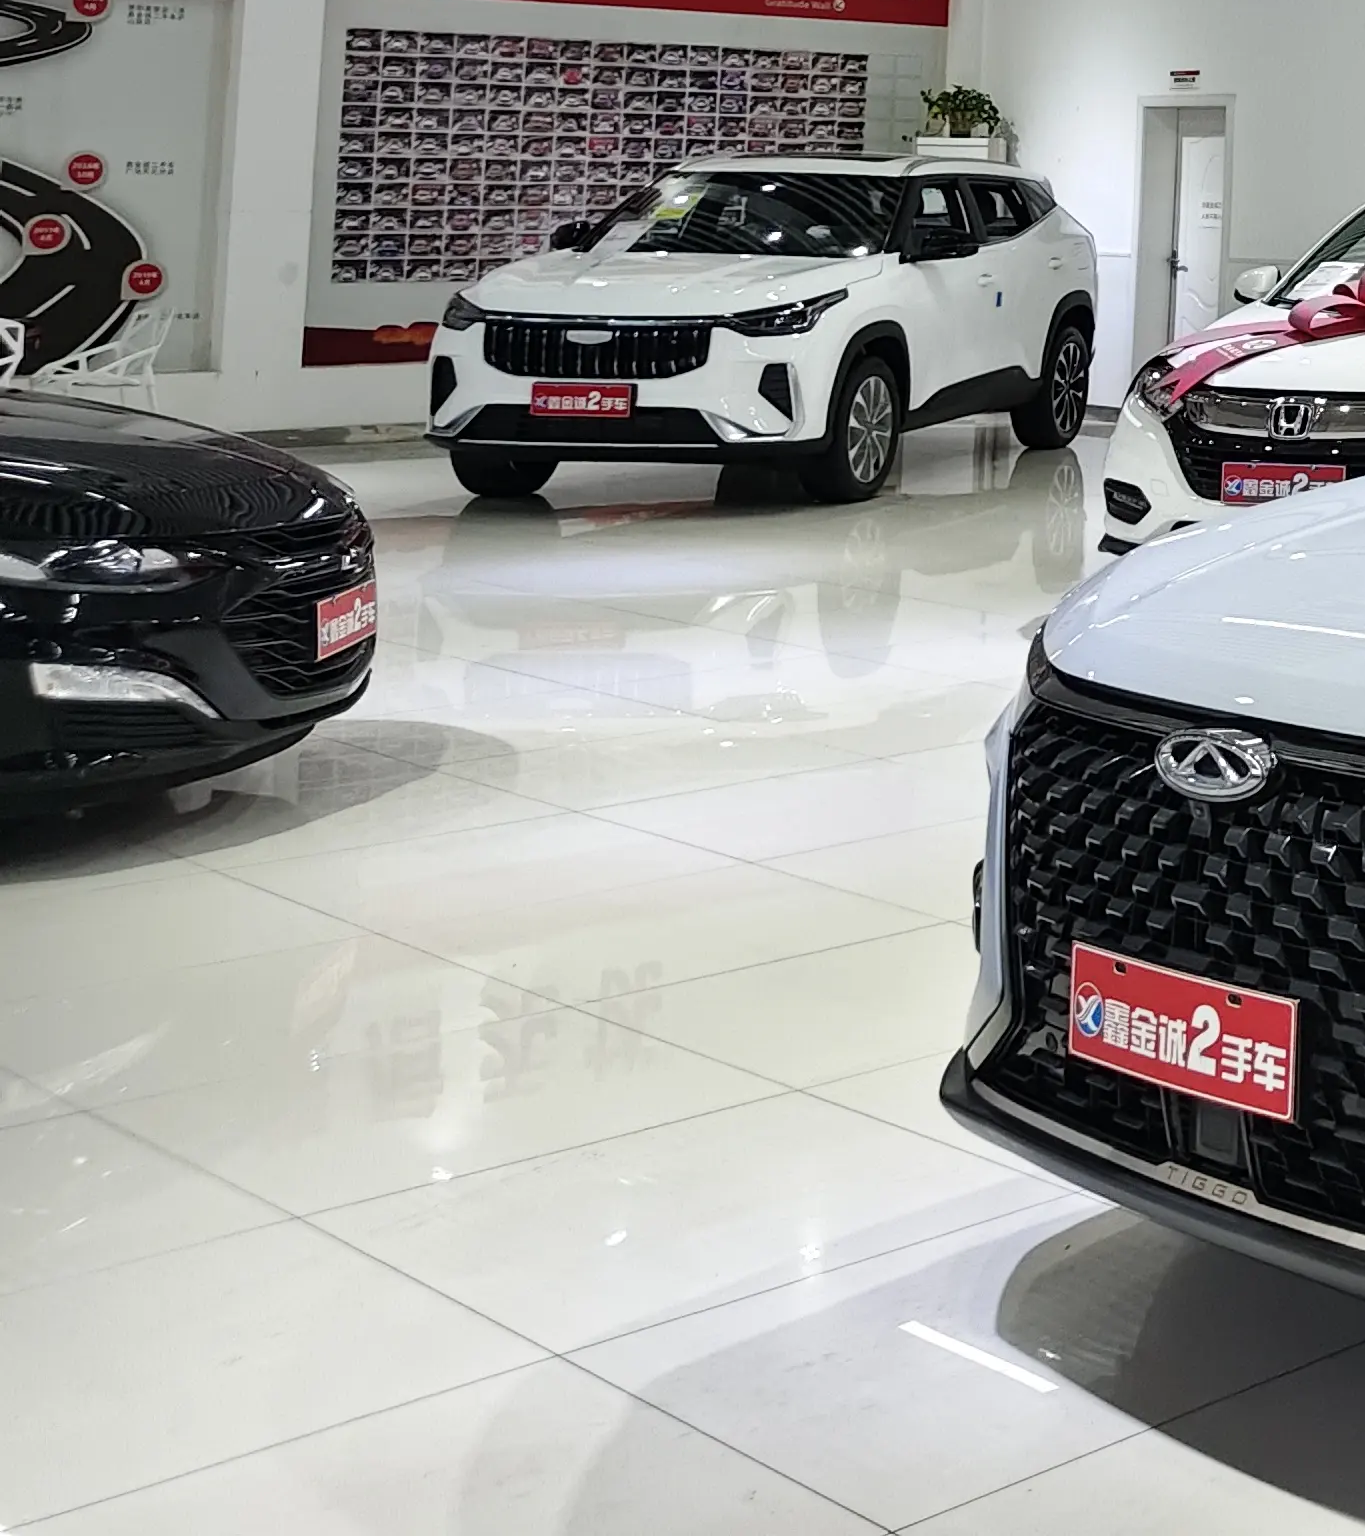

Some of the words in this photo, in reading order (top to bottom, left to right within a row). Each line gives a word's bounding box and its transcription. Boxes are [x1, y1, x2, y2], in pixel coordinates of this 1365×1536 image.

[1102, 997, 1288, 1093] 鑫金诚2手车
[1166, 1164, 1249, 1206] TIGGO
